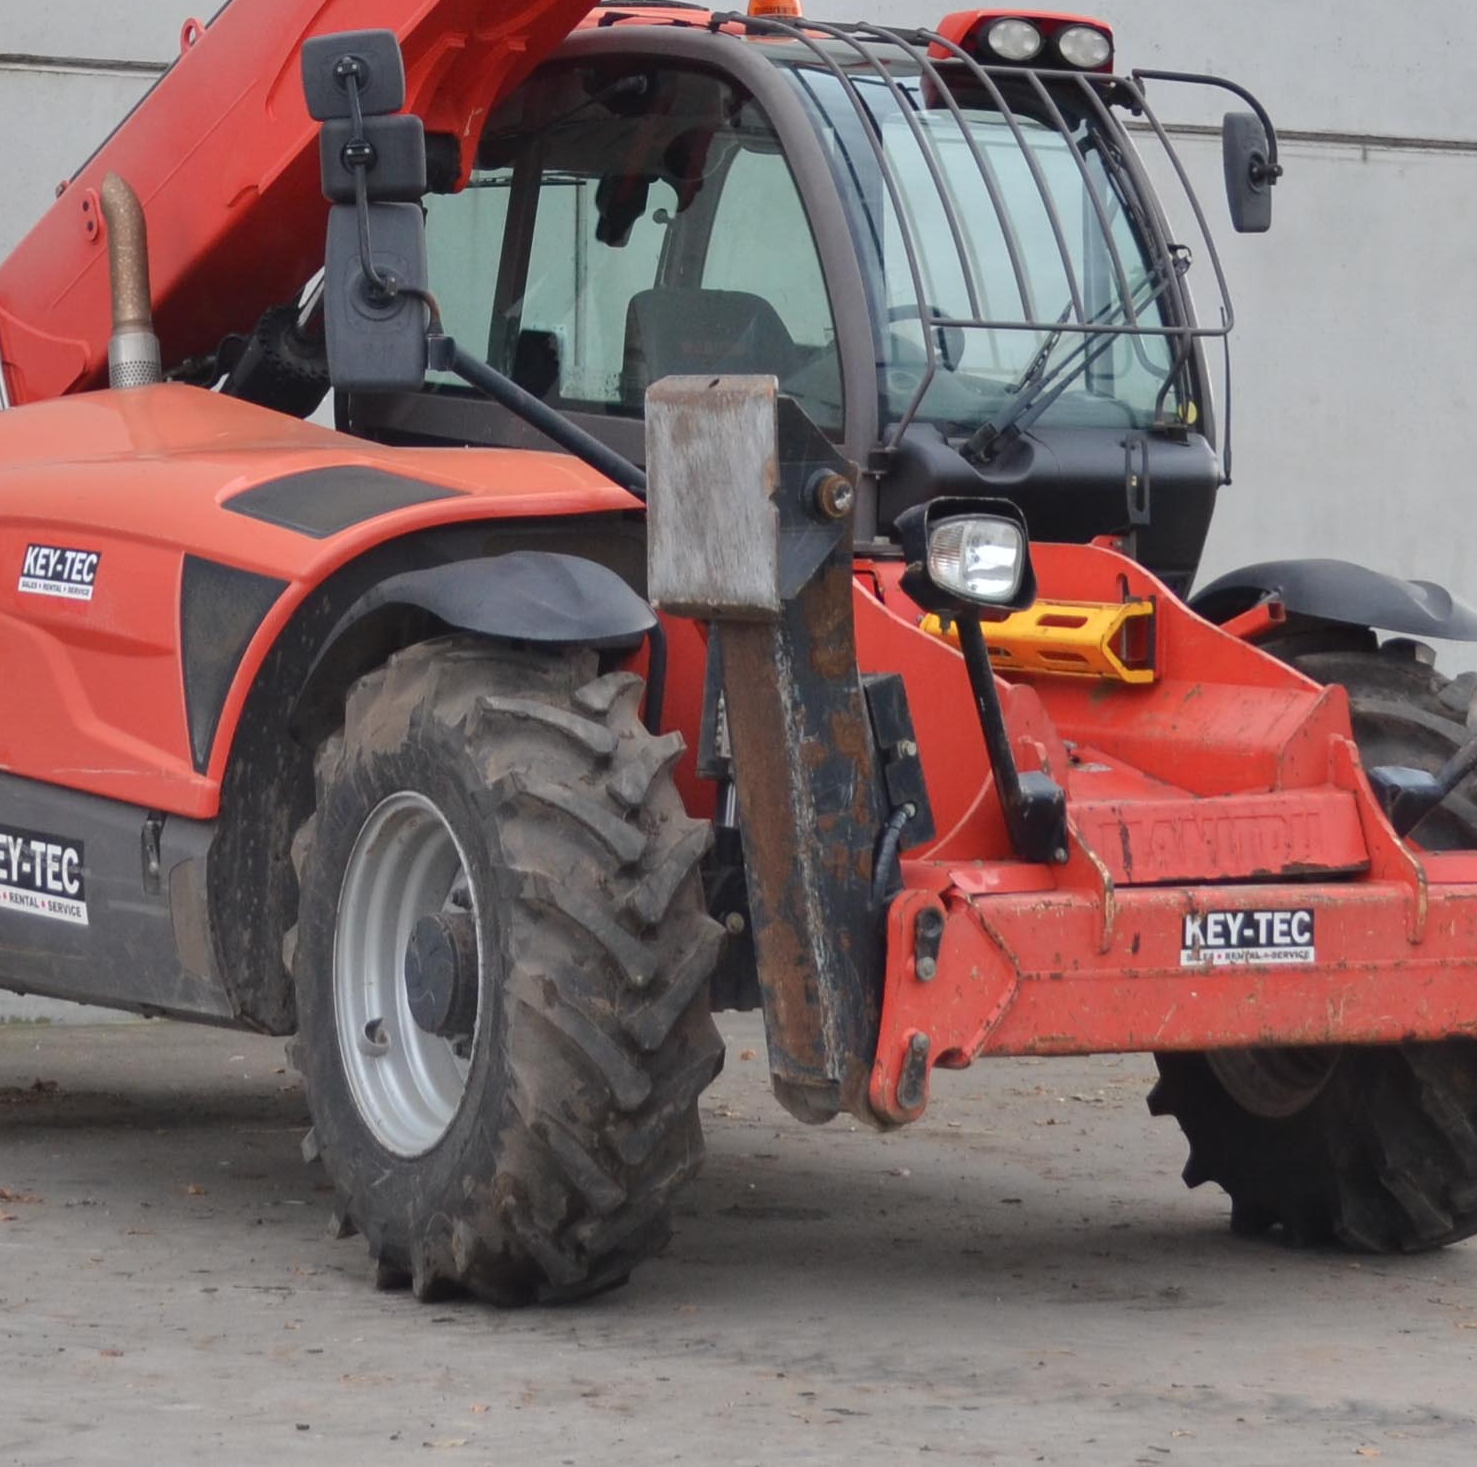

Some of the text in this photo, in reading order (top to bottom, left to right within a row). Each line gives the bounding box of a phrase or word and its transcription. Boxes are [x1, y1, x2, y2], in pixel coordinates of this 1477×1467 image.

[23, 546, 98, 583] KEY-TEC
[9, 892, 39, 909] RENTAL
[47, 900, 82, 918] SERVICE
[1185, 911, 1311, 946] KEY-TEC
